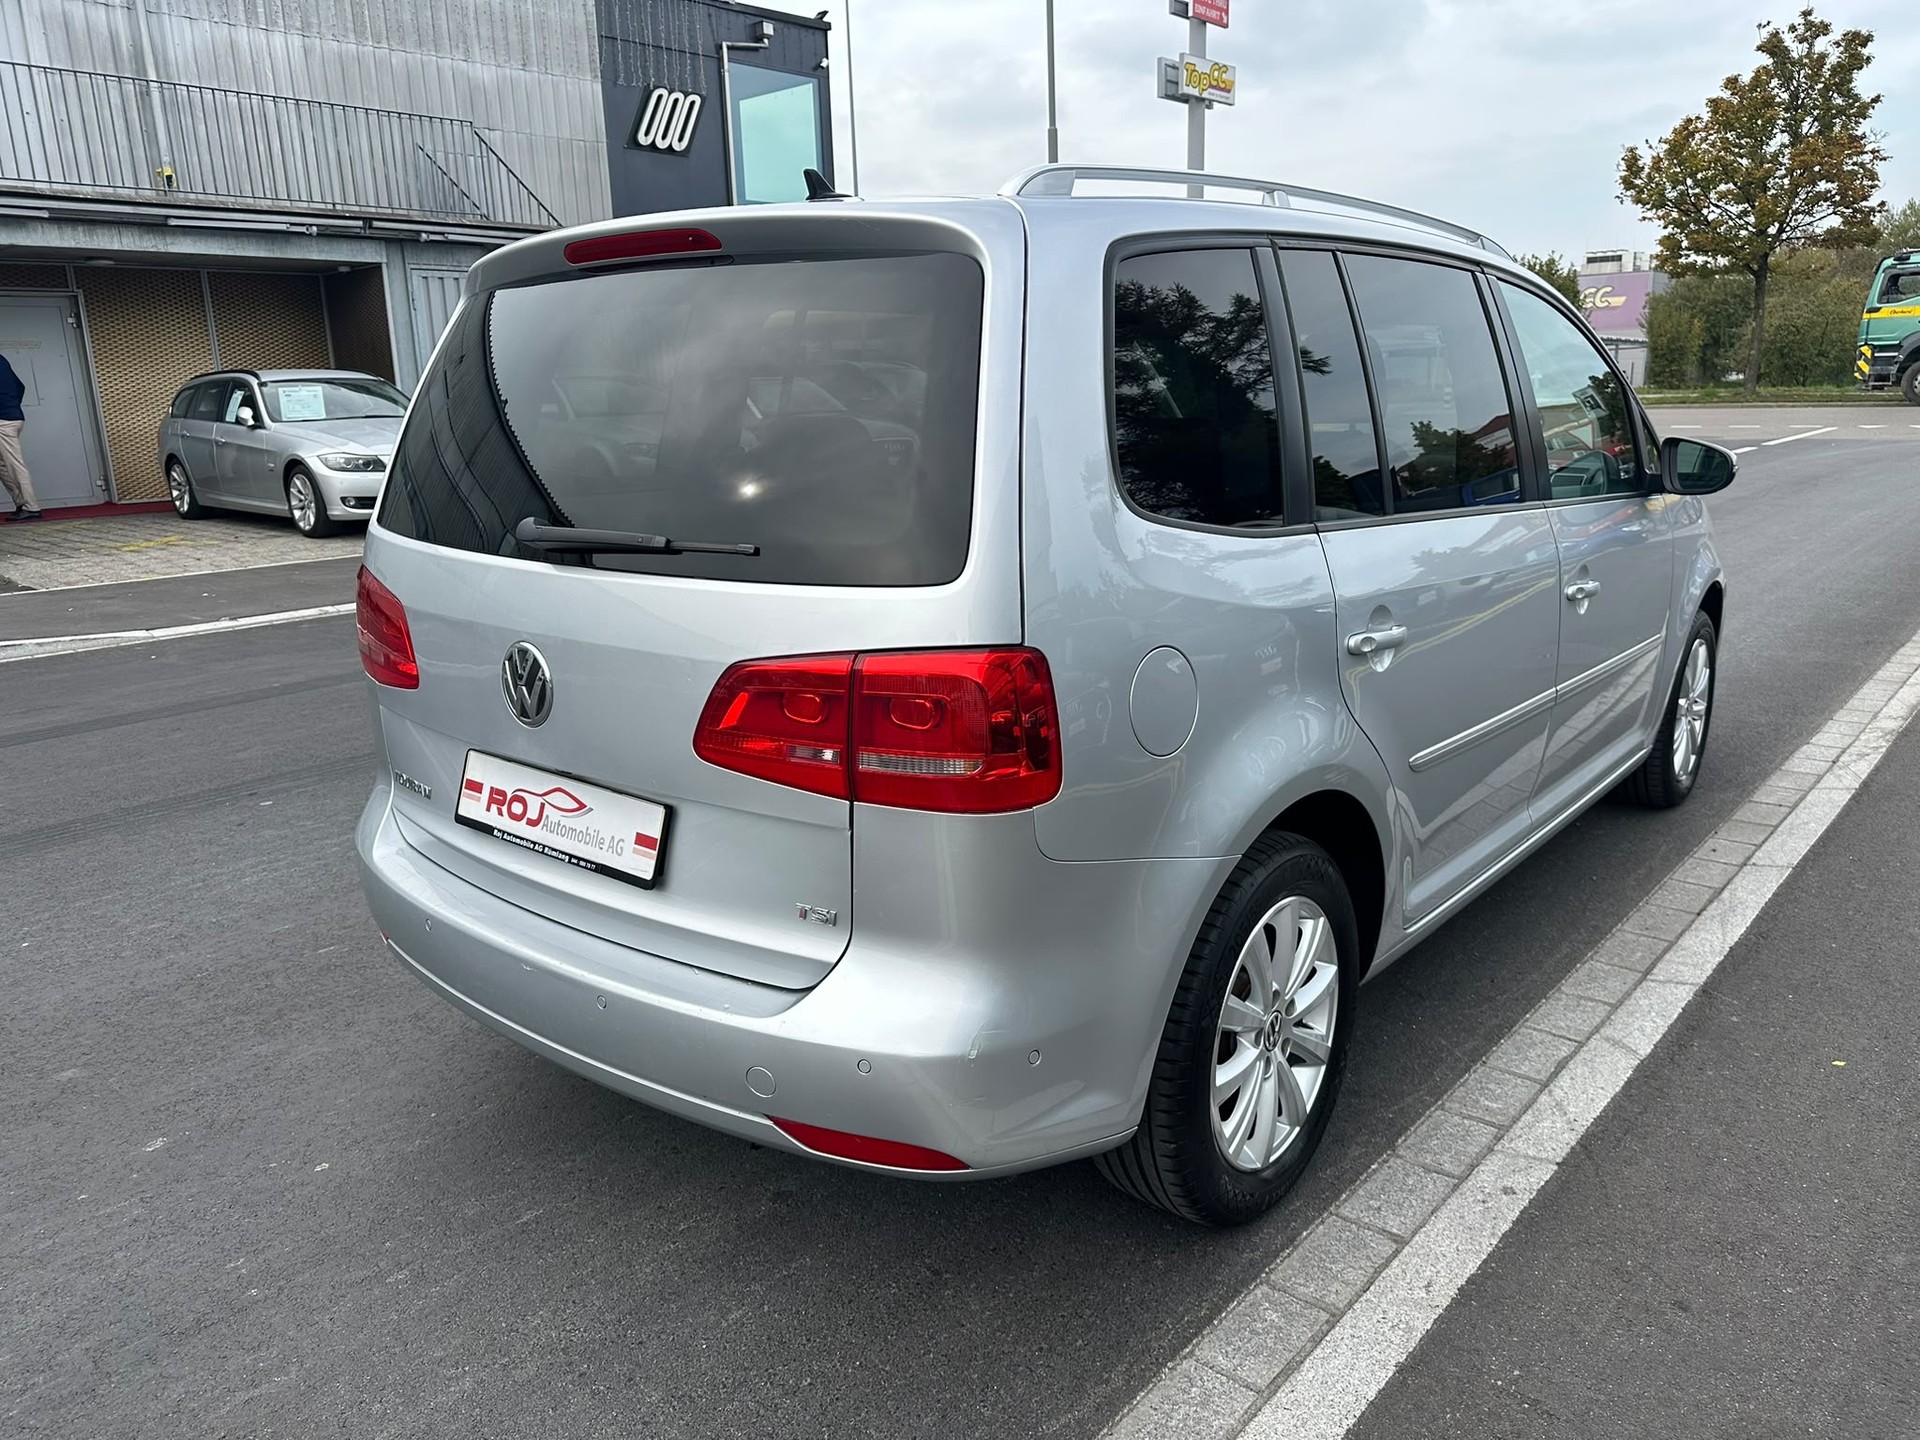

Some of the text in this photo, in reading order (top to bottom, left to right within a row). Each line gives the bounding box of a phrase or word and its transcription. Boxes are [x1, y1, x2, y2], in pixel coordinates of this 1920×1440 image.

[1184, 62, 1229, 96] TopCC
[485, 786, 625, 857] ROJ Automobile AG
[493, 828, 503, 840] Roj
[503, 833, 534, 850] Automobile
[534, 844, 543, 853] AG
[543, 846, 570, 863] Rümlang
[795, 902, 838, 927] TSI
